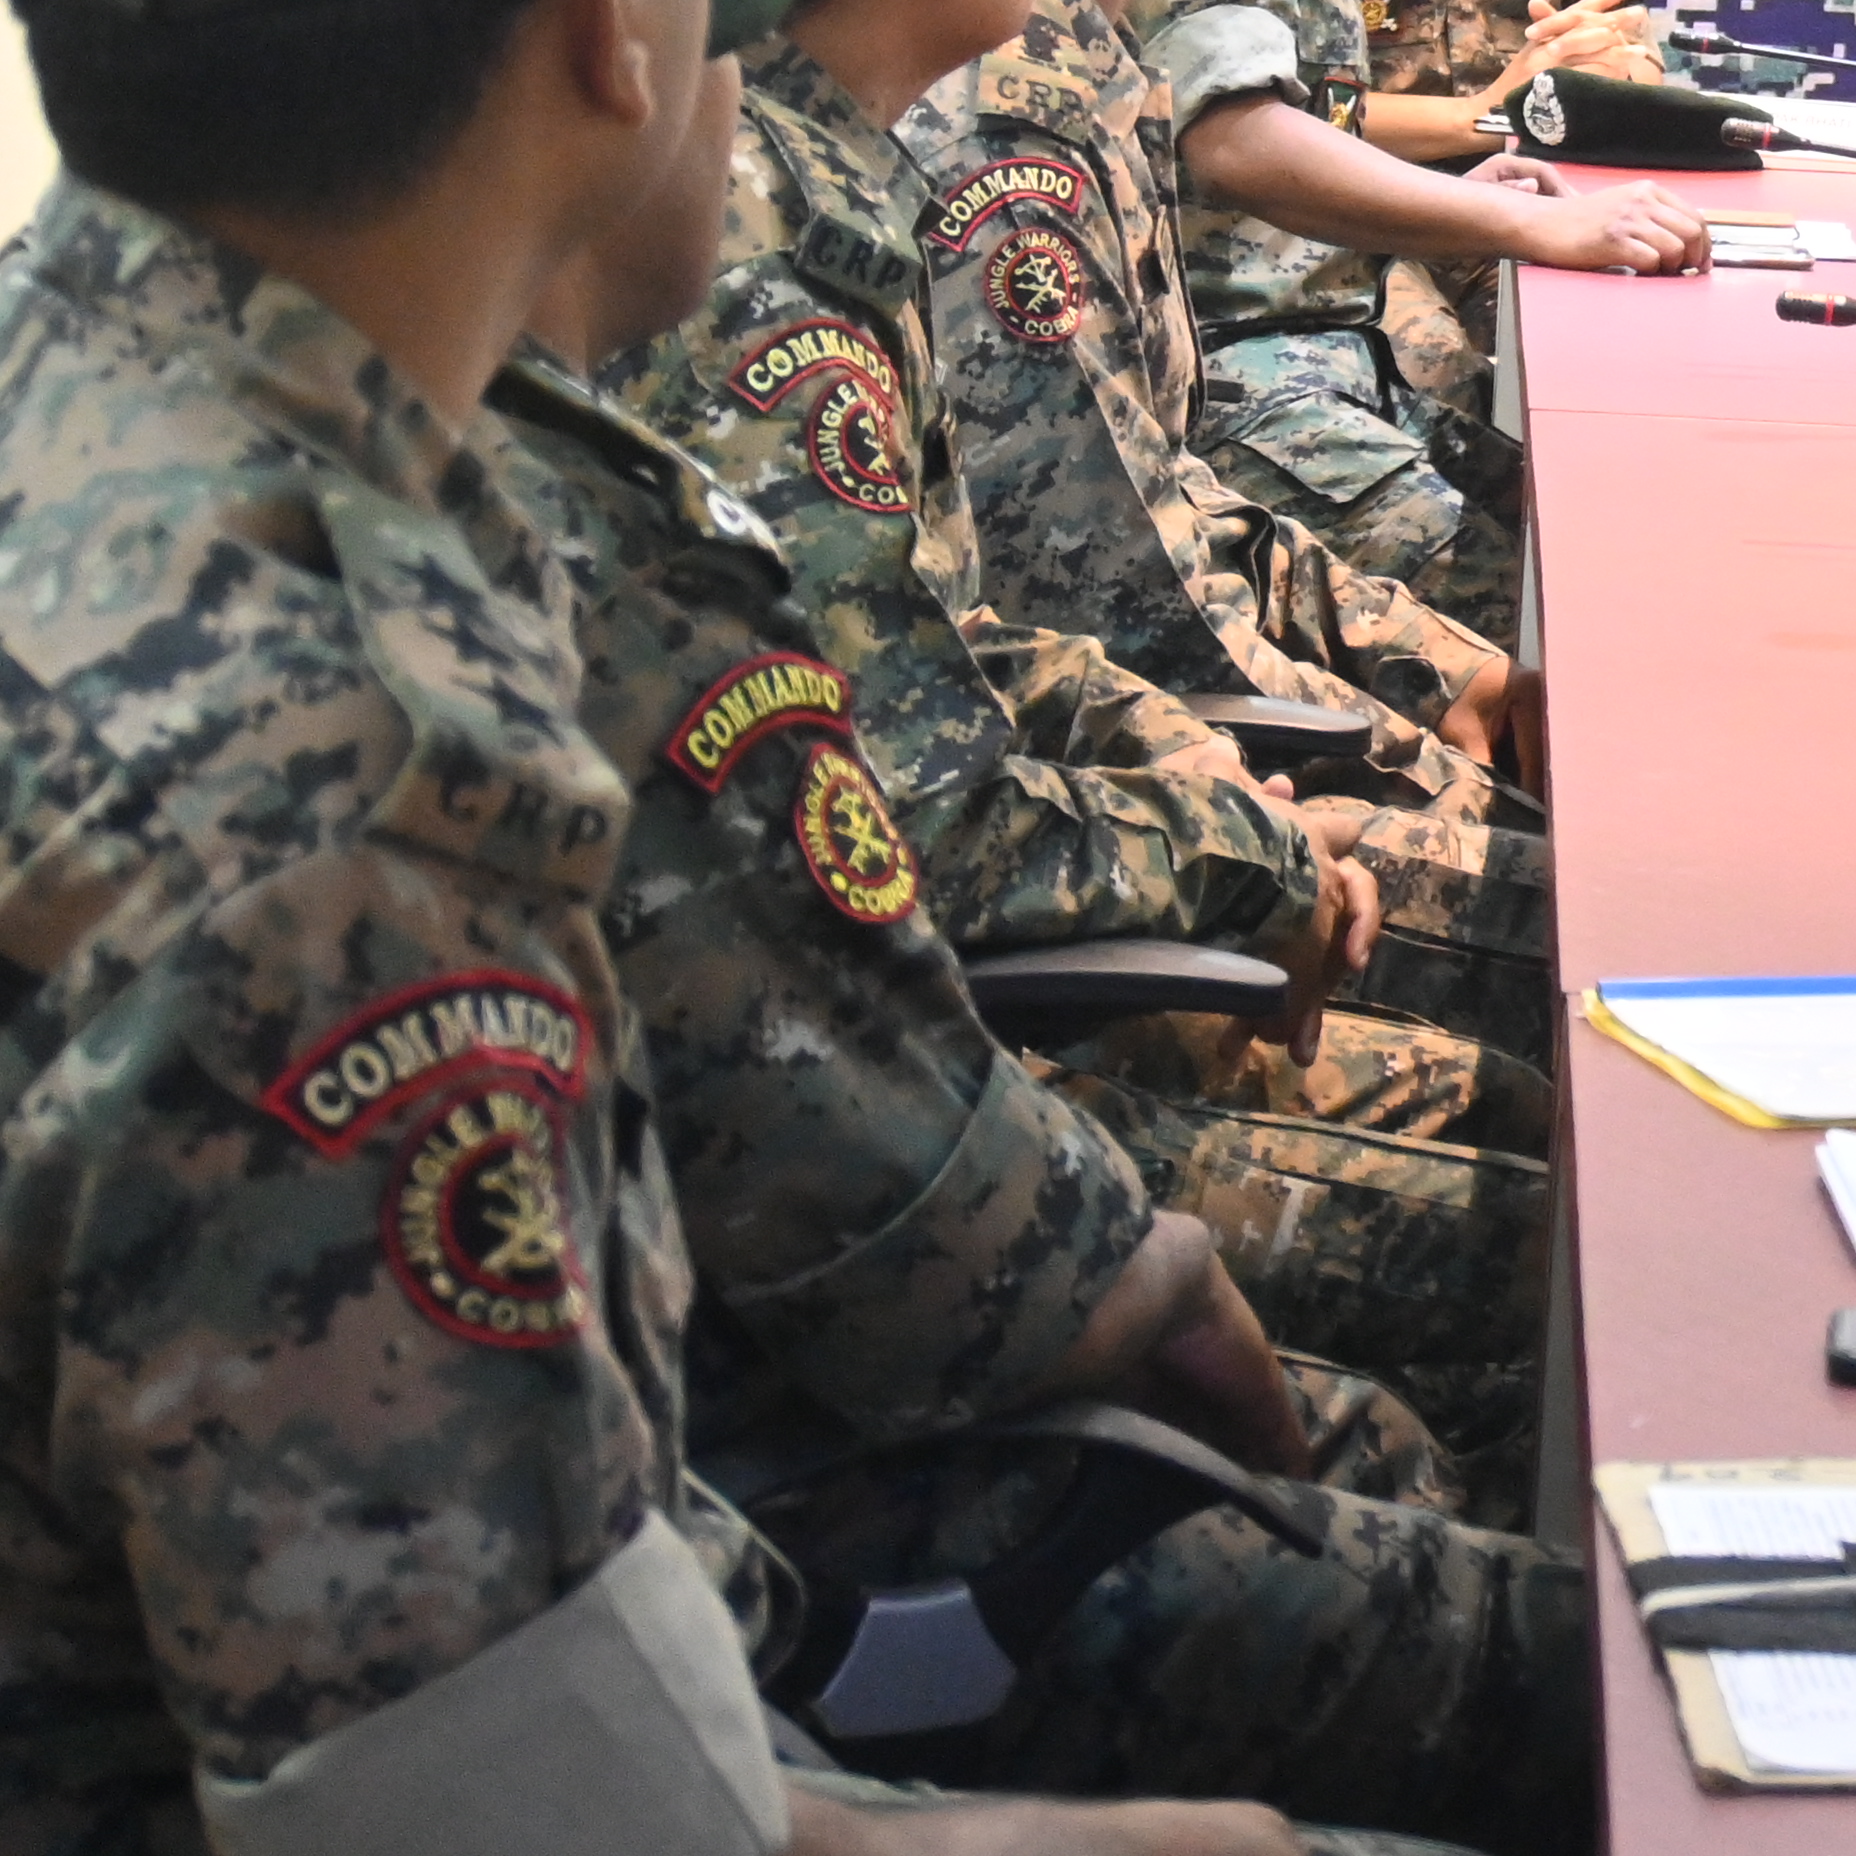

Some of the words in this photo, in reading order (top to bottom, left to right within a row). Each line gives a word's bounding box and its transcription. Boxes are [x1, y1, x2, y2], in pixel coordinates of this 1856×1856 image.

[940, 167, 1073, 236] COMMANDO
[989, 245, 1016, 309] JUNGLE
[1016, 232, 1080, 283] WARRIORS
[1024, 305, 1079, 336] COBRA
[746, 329, 891, 393] COMMANDO
[817, 383, 860, 472] JUNGLE
[687, 663, 842, 769] COMMANDO
[303, 993, 577, 1126] COMMANDO
